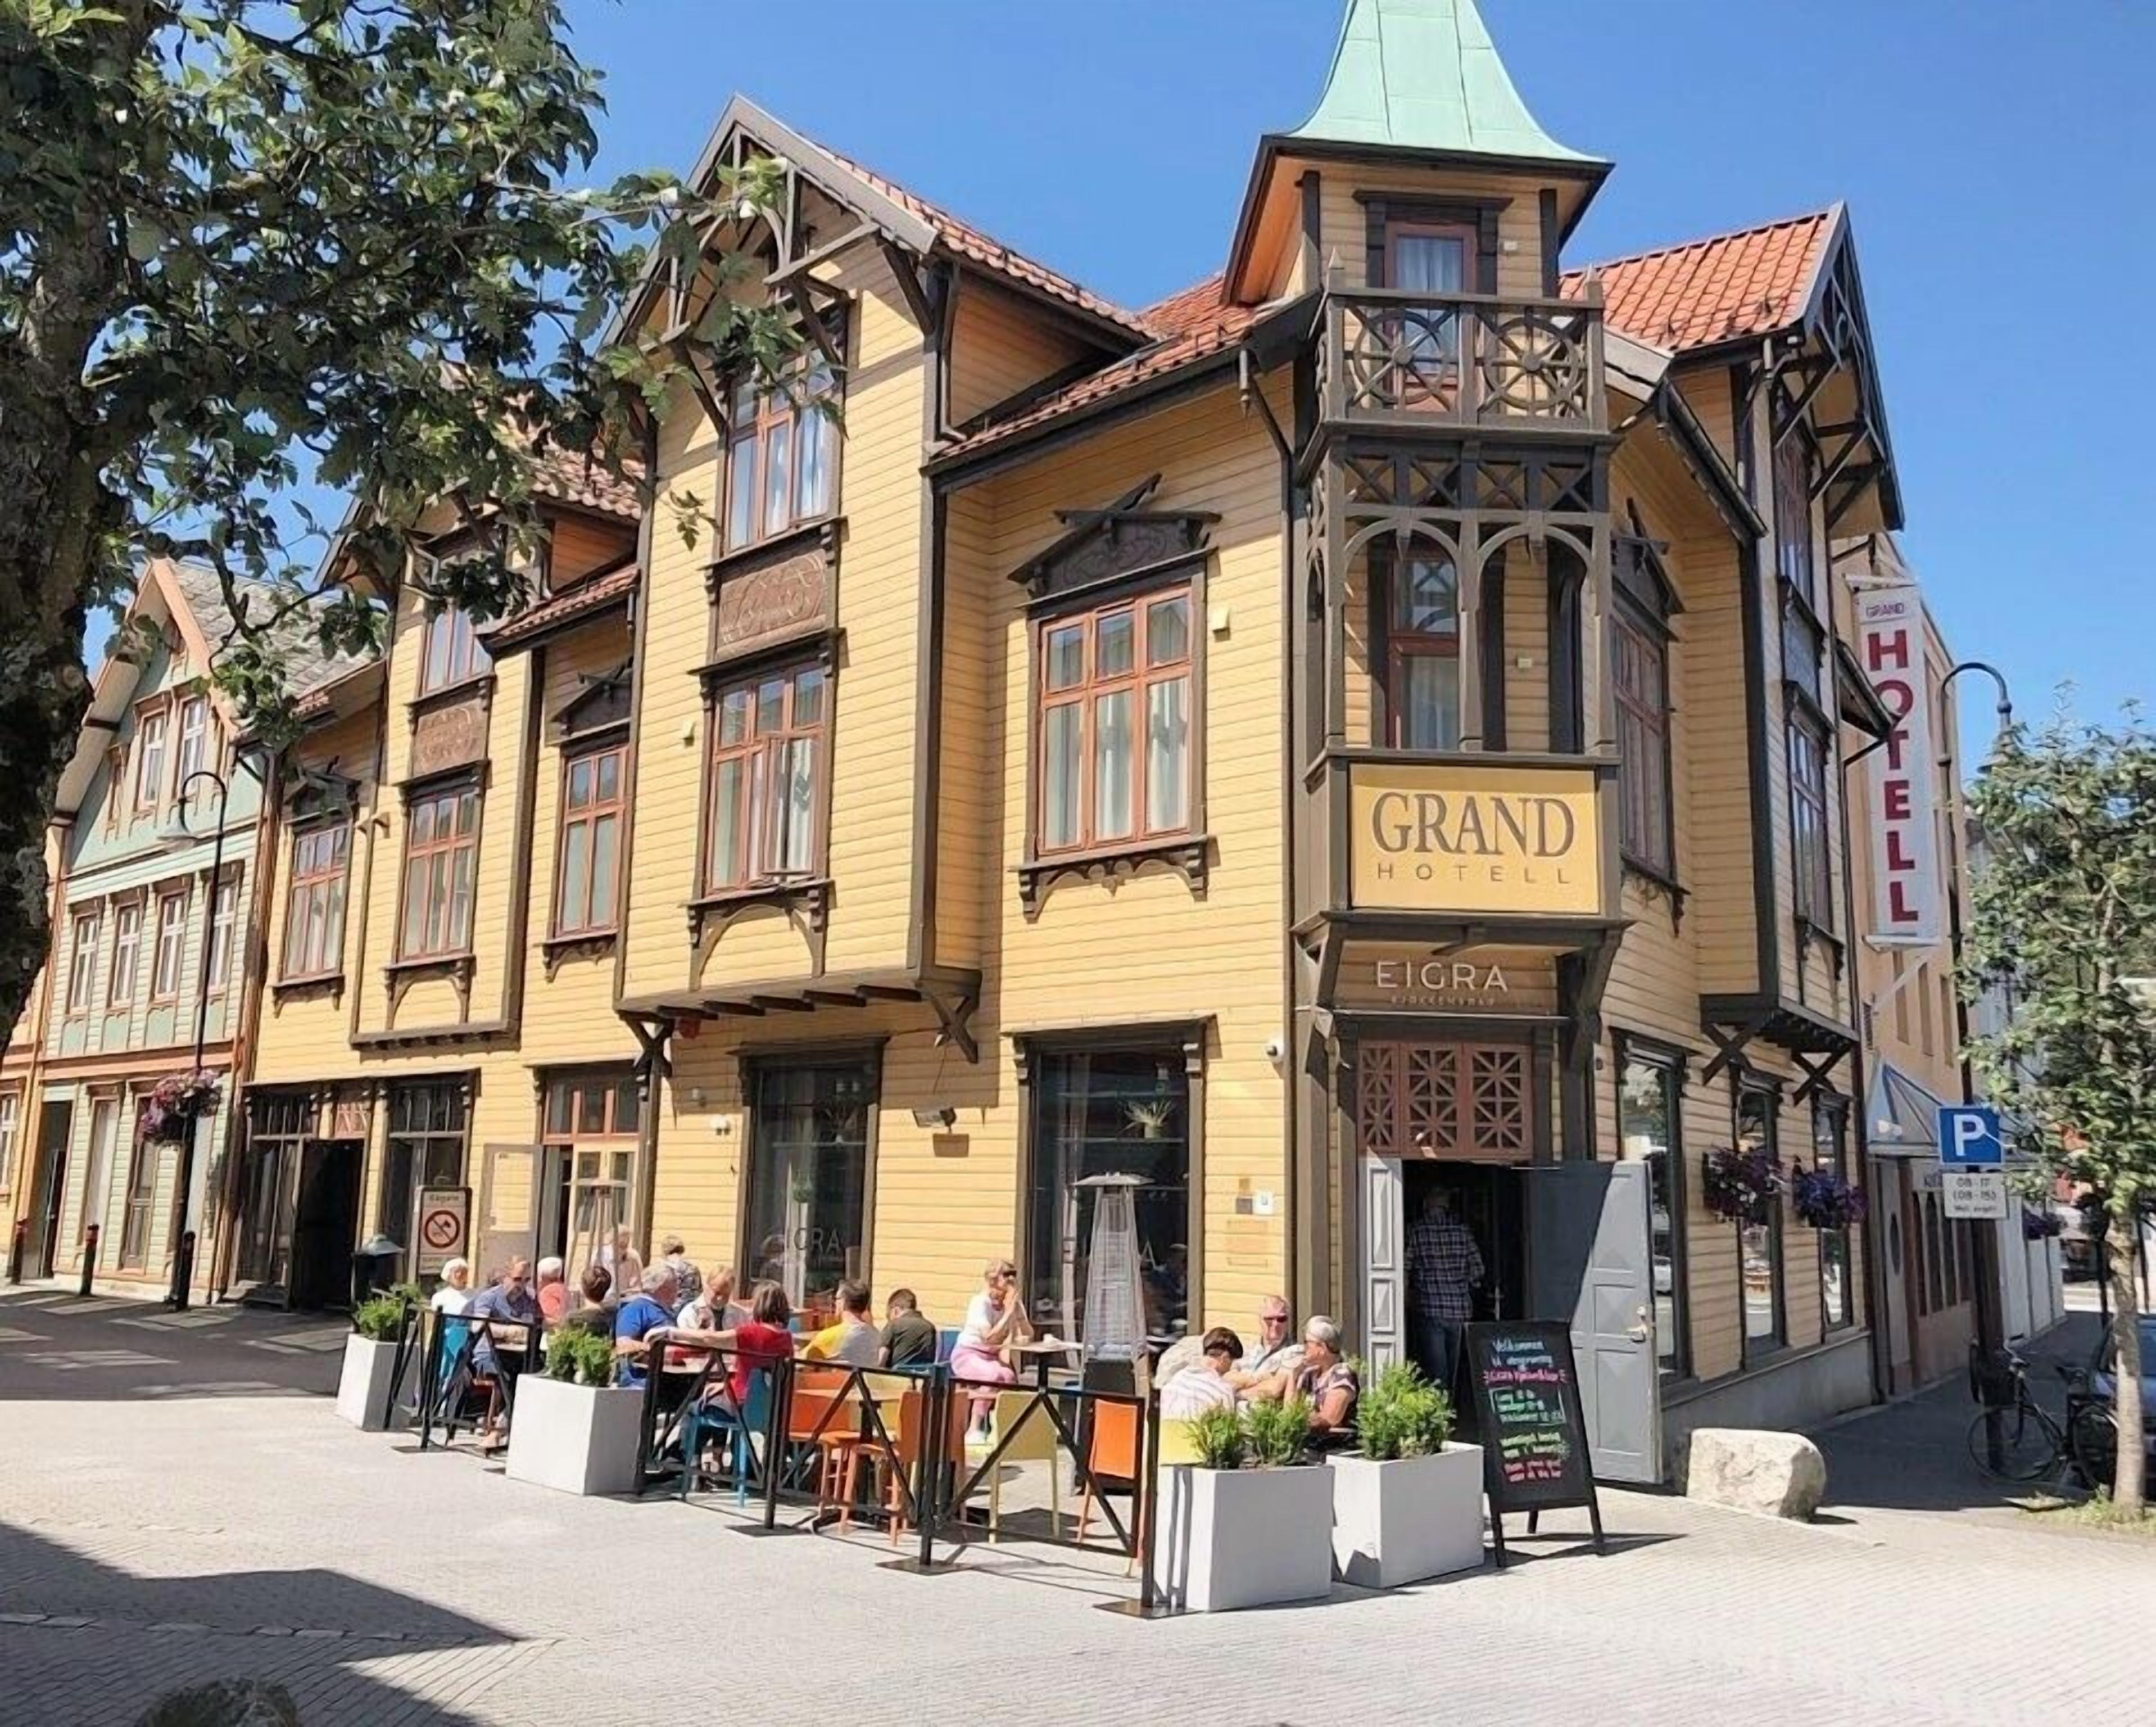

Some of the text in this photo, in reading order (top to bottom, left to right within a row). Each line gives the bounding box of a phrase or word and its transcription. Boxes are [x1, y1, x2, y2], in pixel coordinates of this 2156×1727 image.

[1868, 629, 1919, 922] HOTELL
[1373, 792, 1574, 857] GRAND
[1378, 863, 1570, 884] HOTELL
[1378, 961, 1509, 993] EIGRA
[1953, 1114, 1986, 1156] P
